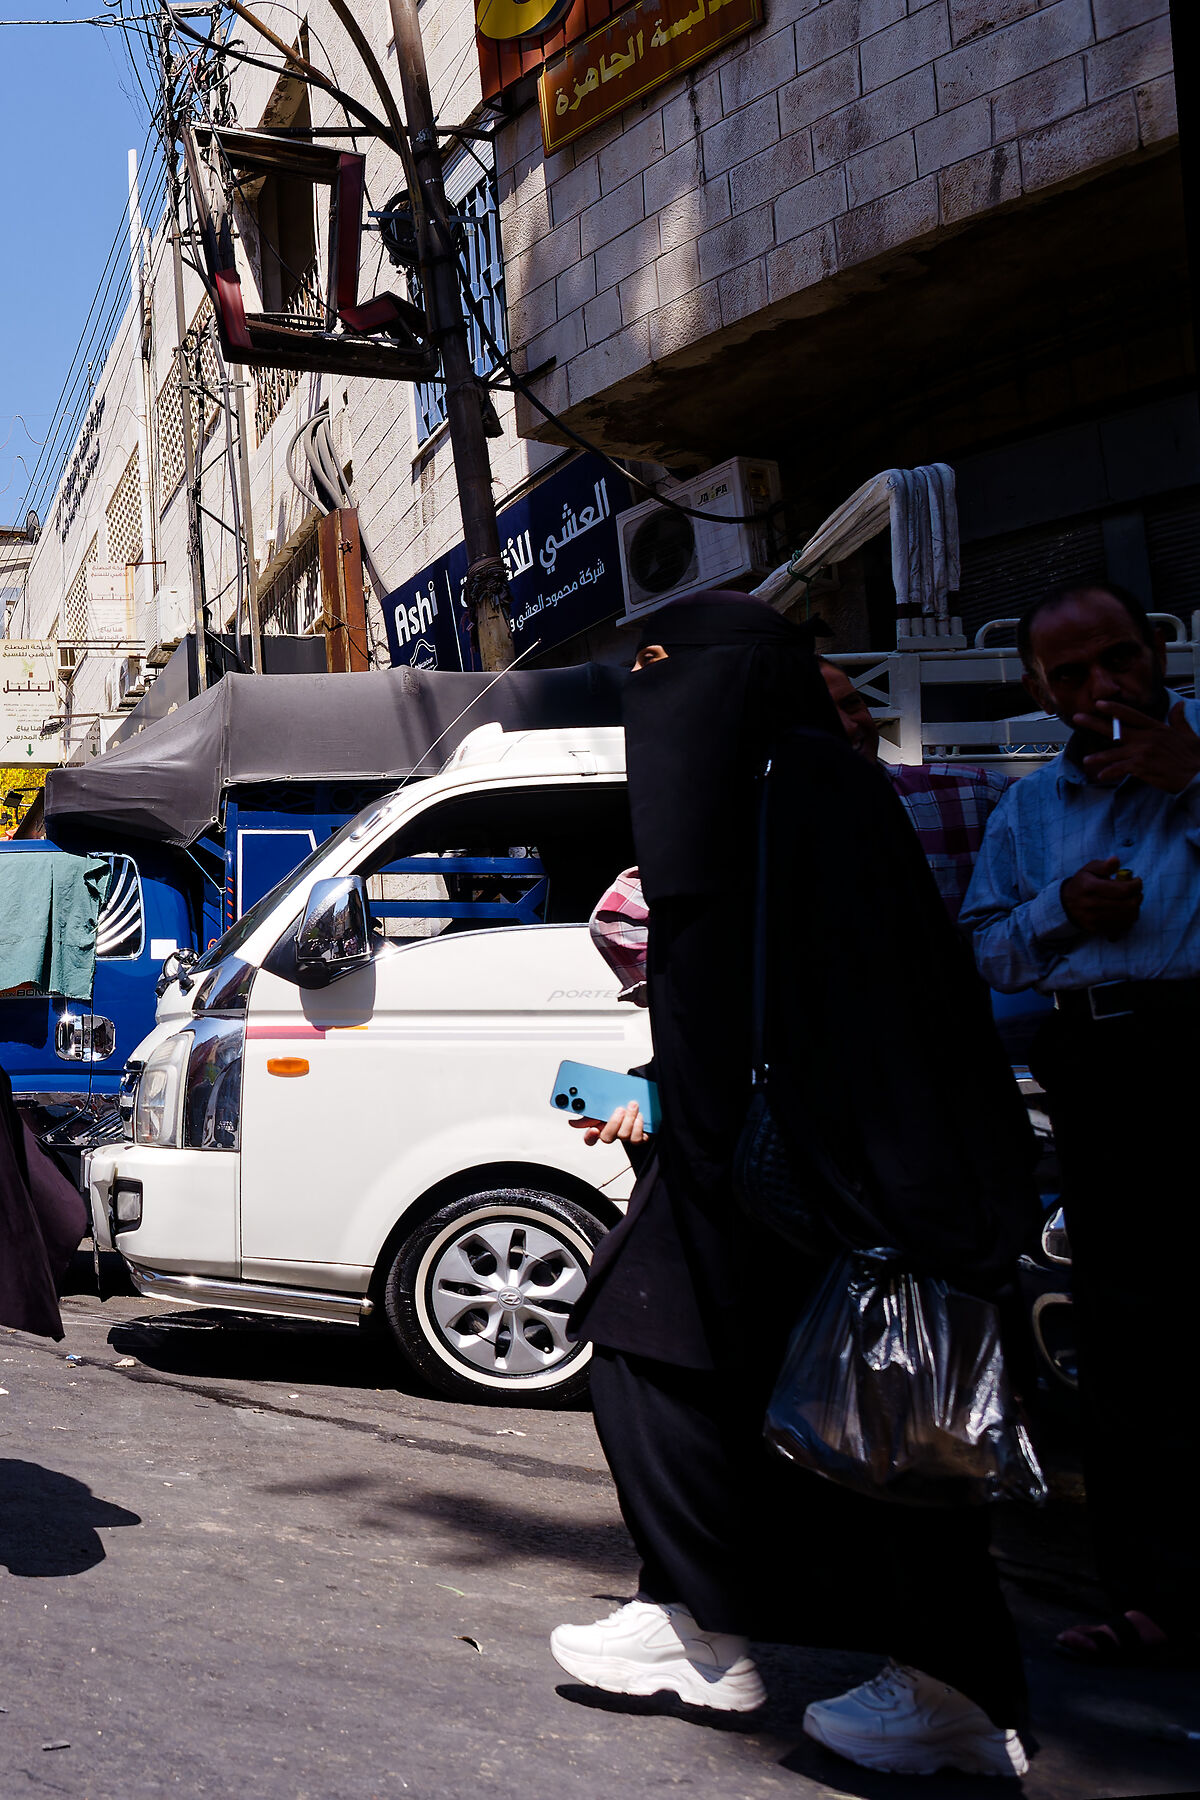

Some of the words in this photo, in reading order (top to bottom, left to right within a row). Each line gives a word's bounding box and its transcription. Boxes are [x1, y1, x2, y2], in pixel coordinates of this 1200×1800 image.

[554, 29, 645, 116] الجاهزة
[539, 477, 611, 575] العشي
[579, 558, 606, 586] شركة
[545, 581, 579, 608] محمود
[394, 581, 439, 648] Ashi
[515, 594, 545, 632] العشي
[2, 680, 55, 696] البلبل
[547, 989, 619, 1002] PORTE
